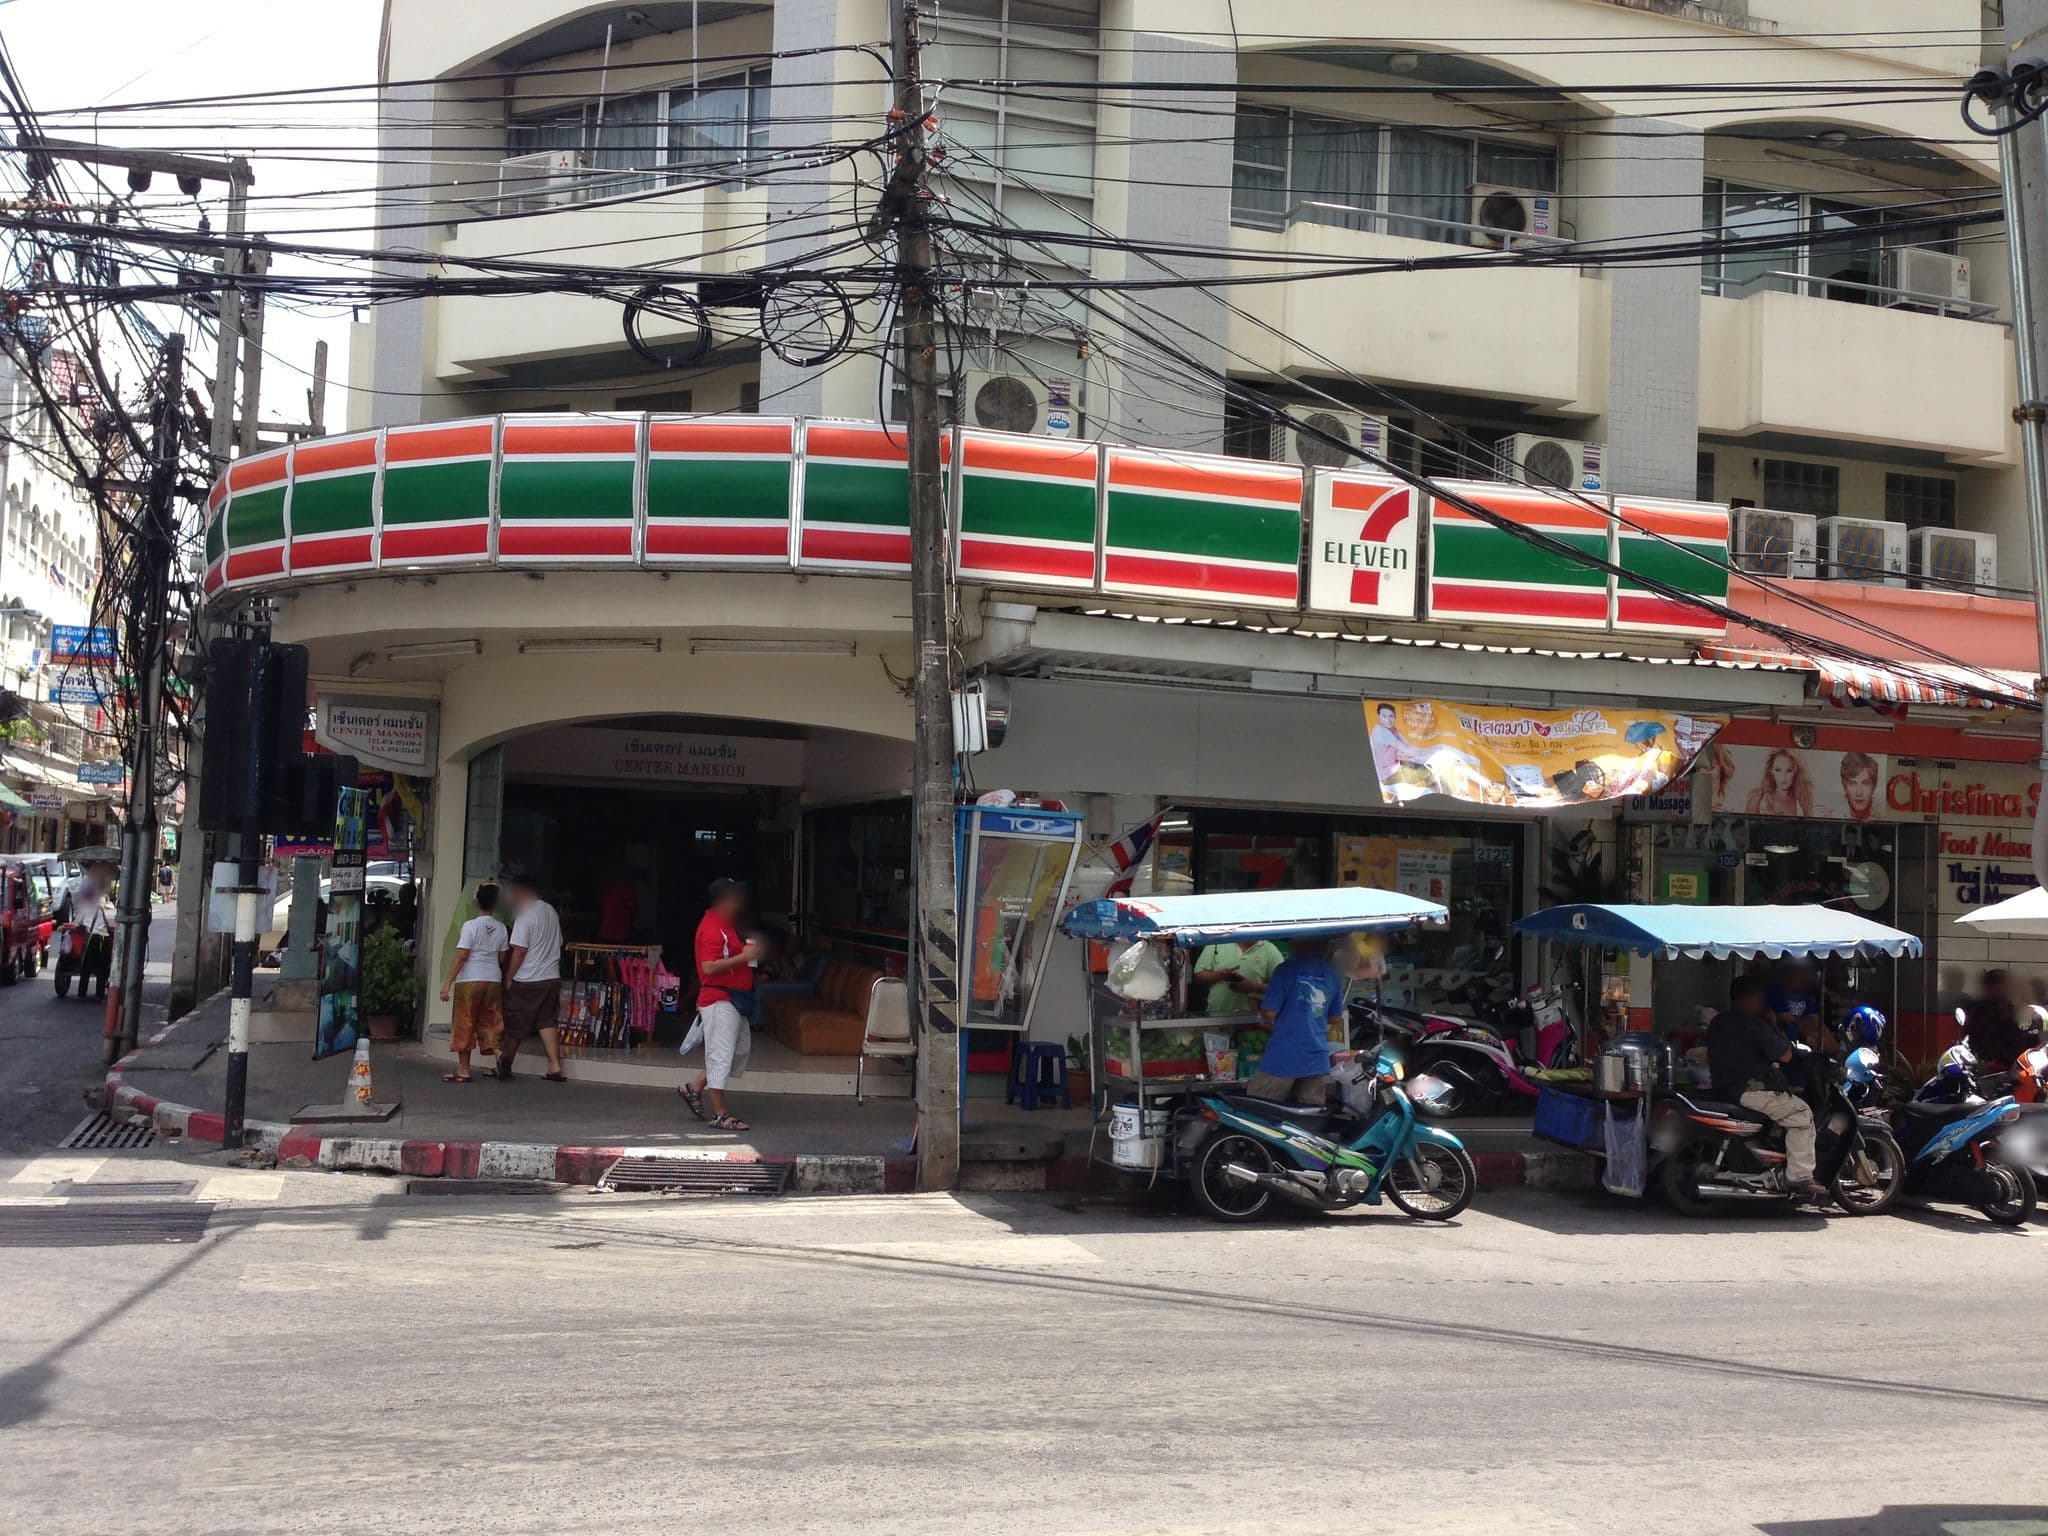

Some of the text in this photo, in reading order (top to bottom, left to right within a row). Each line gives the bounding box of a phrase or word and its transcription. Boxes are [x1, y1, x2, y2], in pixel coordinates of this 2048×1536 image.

[1331, 480, 1410, 605] 7
[1890, 546, 1902, 556] LG
[332, 727, 423, 739] CENTER MANSION
[614, 758, 745, 777] CENTER MANSION
[1631, 795, 1691, 815] Oil Massage
[1886, 772, 2023, 818] Christina
[1939, 831, 1979, 856] Foot
